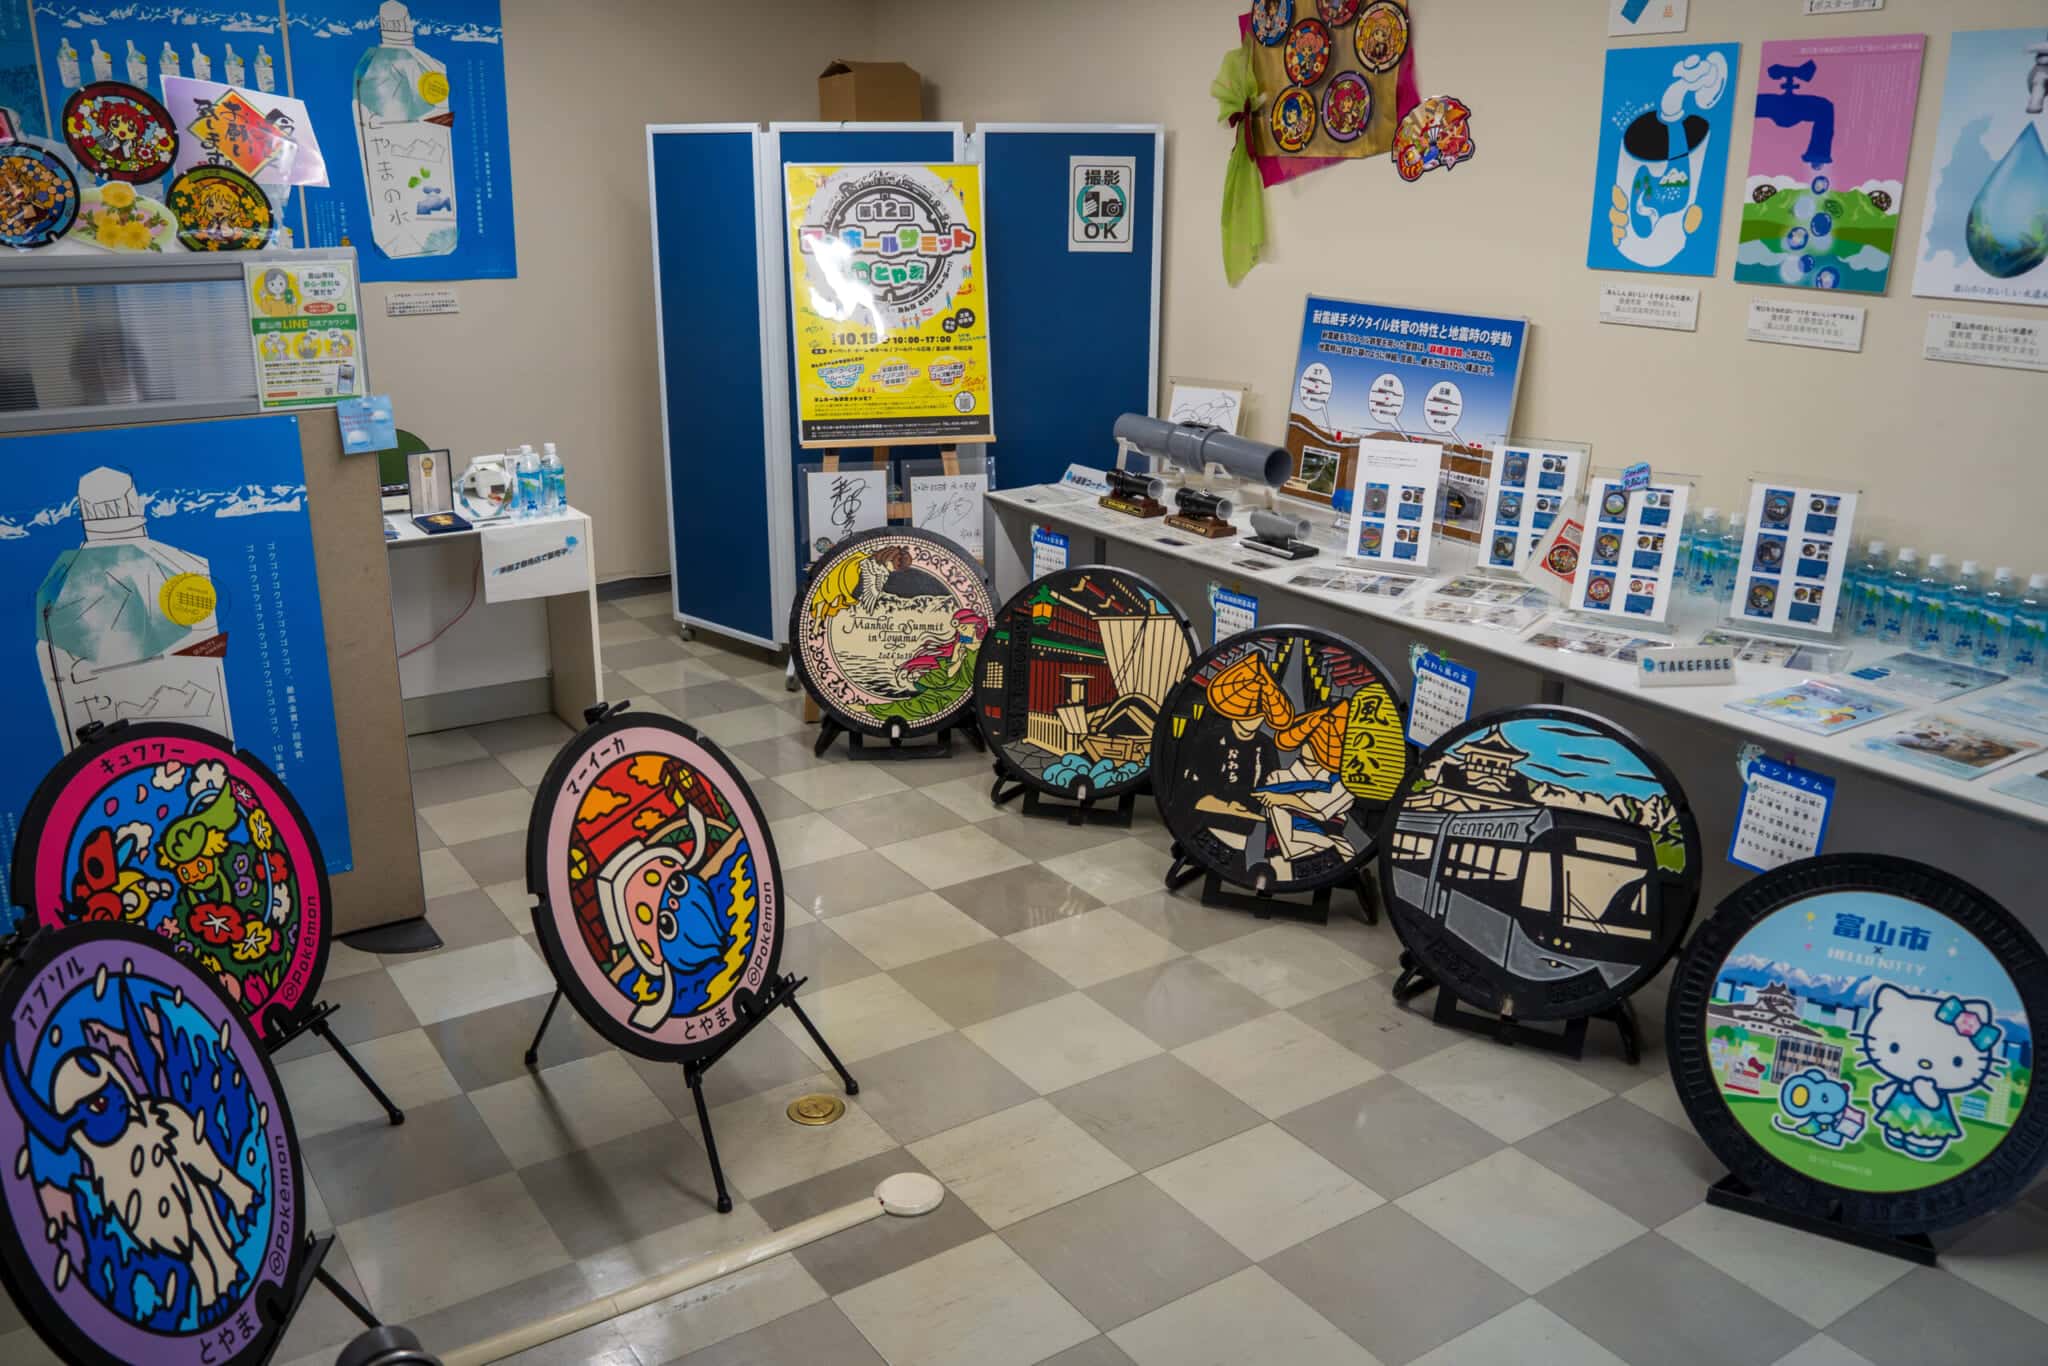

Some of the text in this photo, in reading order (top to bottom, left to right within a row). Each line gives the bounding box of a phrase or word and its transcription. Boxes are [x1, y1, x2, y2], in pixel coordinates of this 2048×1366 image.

[1085, 169, 1120, 185] 撮影
[1084, 223, 1118, 240] OK
[842, 615, 944, 634] Manhole Summit
[868, 631, 918, 650] in Toyama
[1346, 694, 1390, 786] 風の盆
[99, 742, 186, 775] キュワワー
[565, 736, 626, 796] マーイーカ
[1227, 748, 1239, 783] おわら
[1759, 763, 1822, 791] セントラム
[1452, 822, 1519, 840] CENTRAM
[1833, 913, 1932, 951] 富山市
[20, 956, 86, 1031] アブソル
[683, 1007, 732, 1041] とやま
[200, 1311, 256, 1365] とやま
